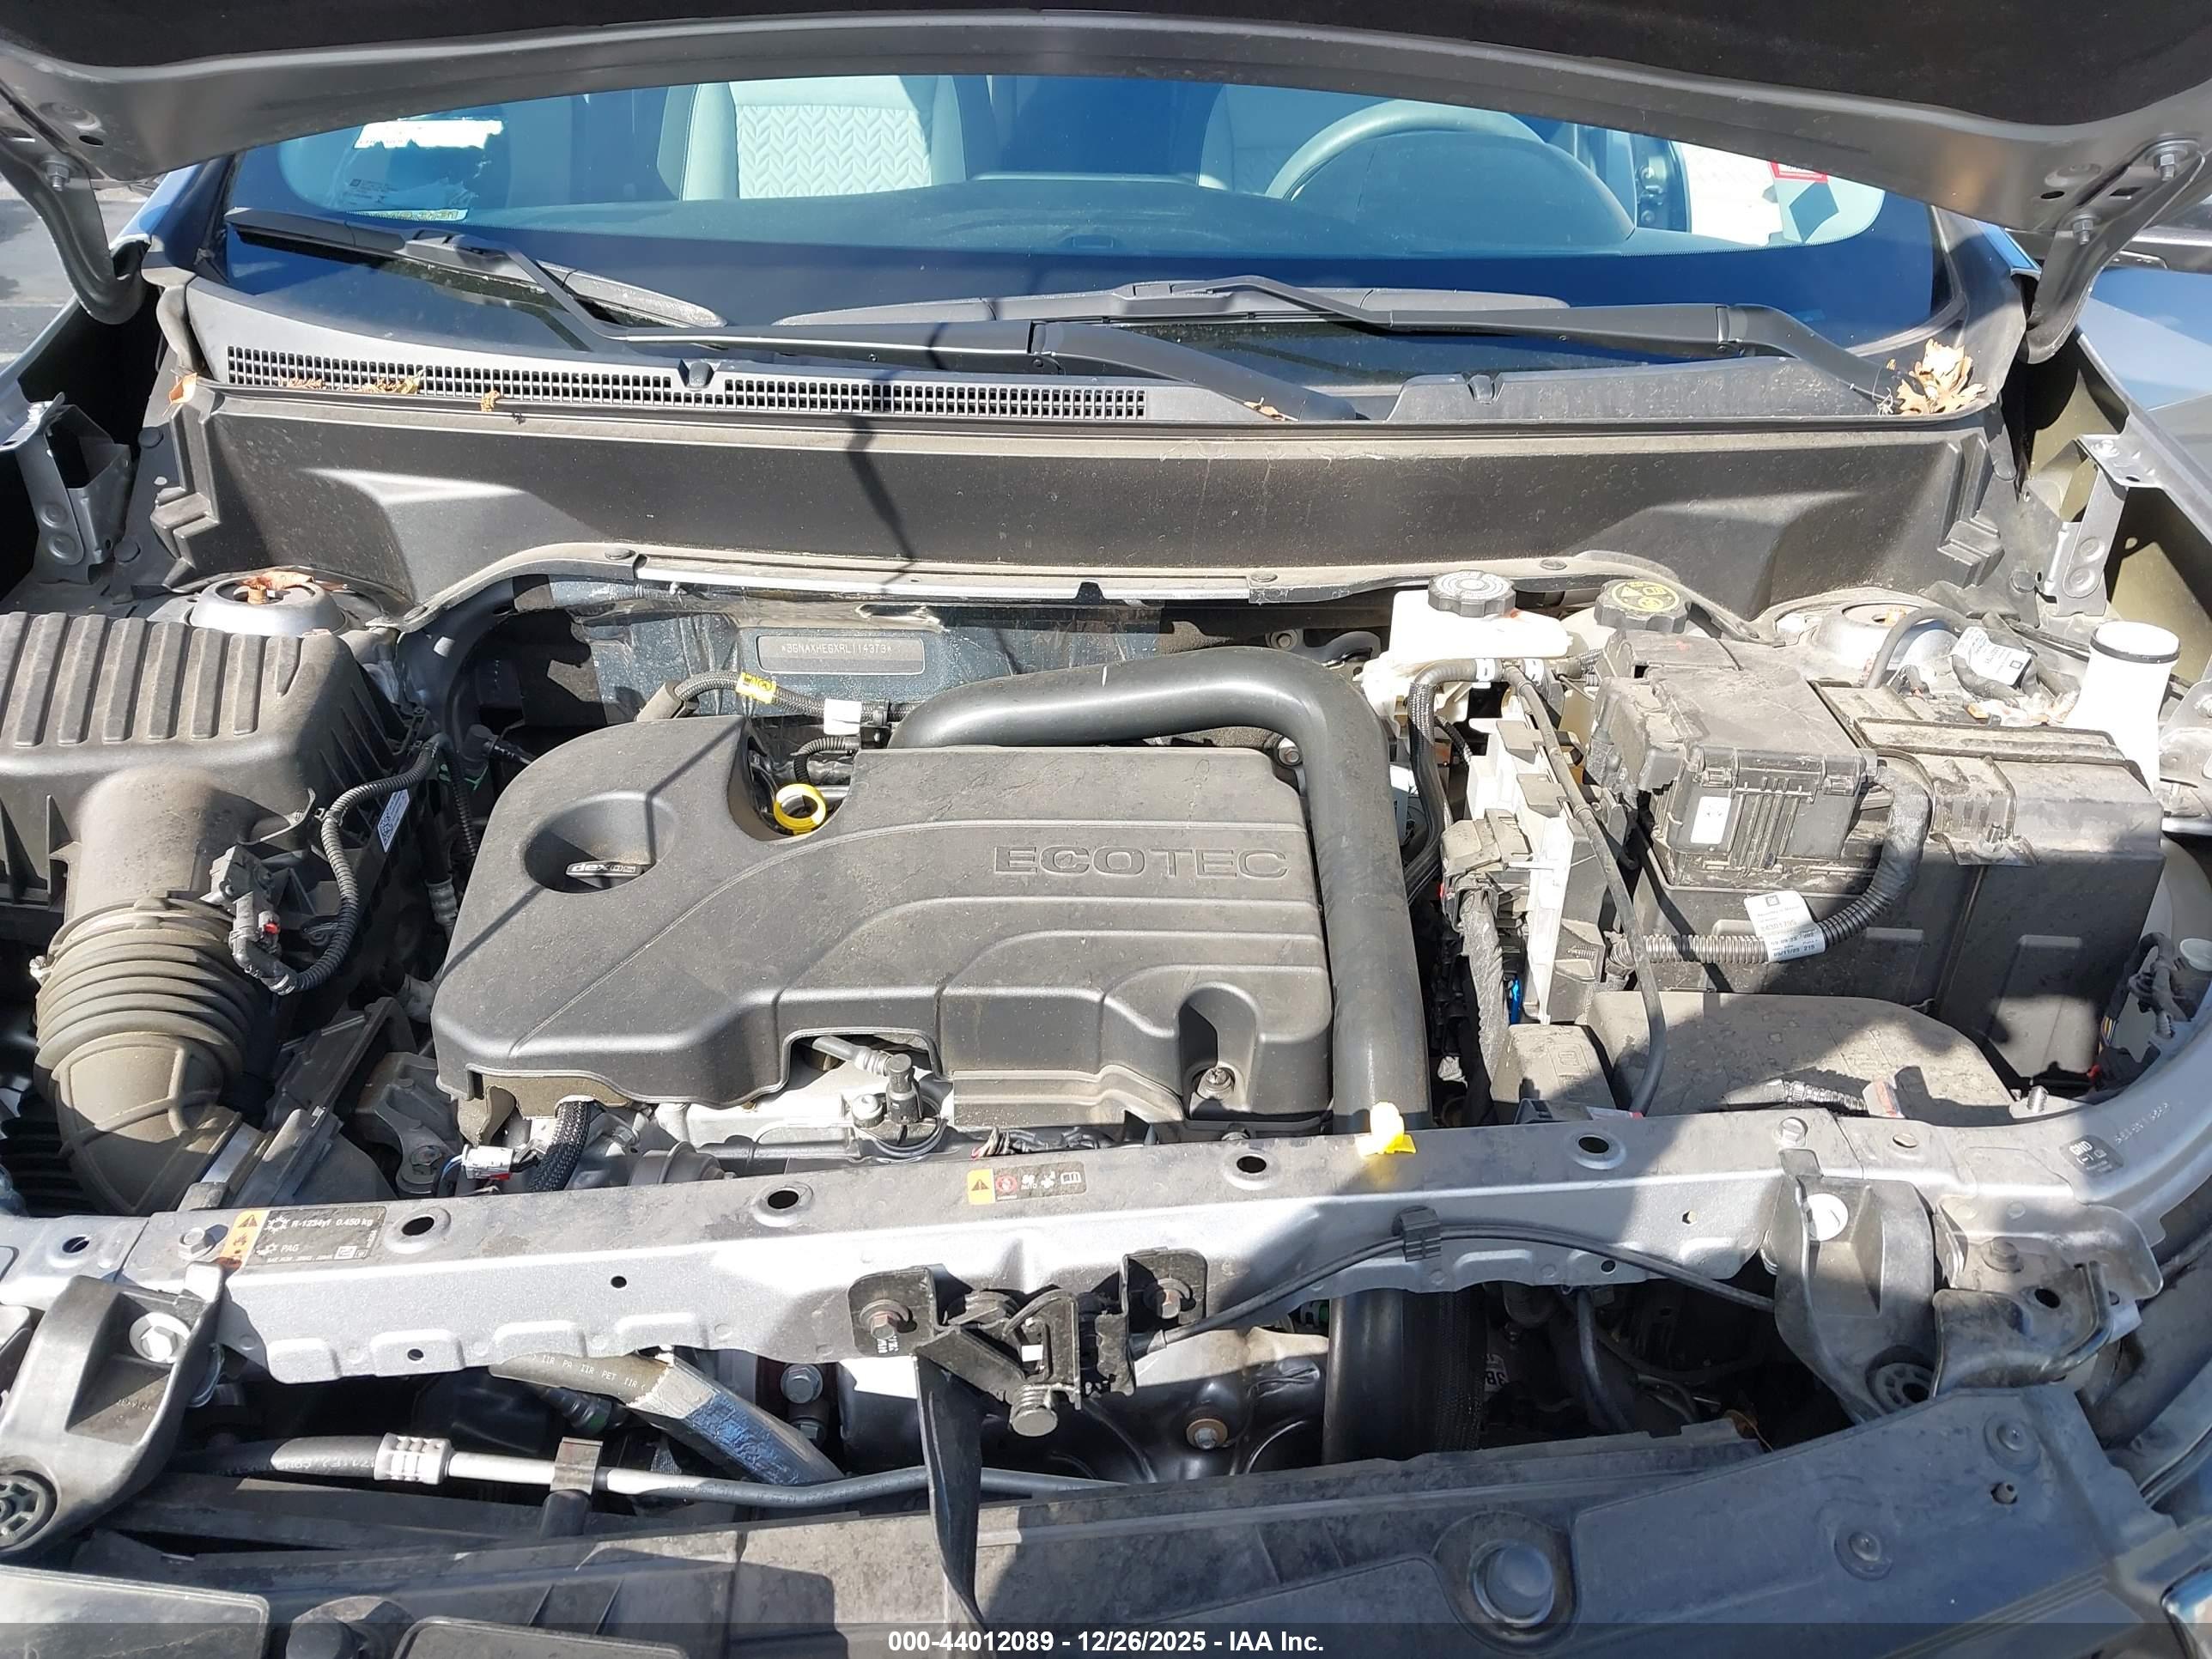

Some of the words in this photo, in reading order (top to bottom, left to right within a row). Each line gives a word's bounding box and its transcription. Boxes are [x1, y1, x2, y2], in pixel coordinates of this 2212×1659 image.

[994, 845, 1289, 879] ECOTEC
[2069, 1140, 2094, 1156] GND
[291, 1218, 331, 1228] R-1234yf
[336, 1218, 361, 1226] 0.450
[362, 1218, 374, 1227] kg
[280, 1243, 300, 1253] PAG
